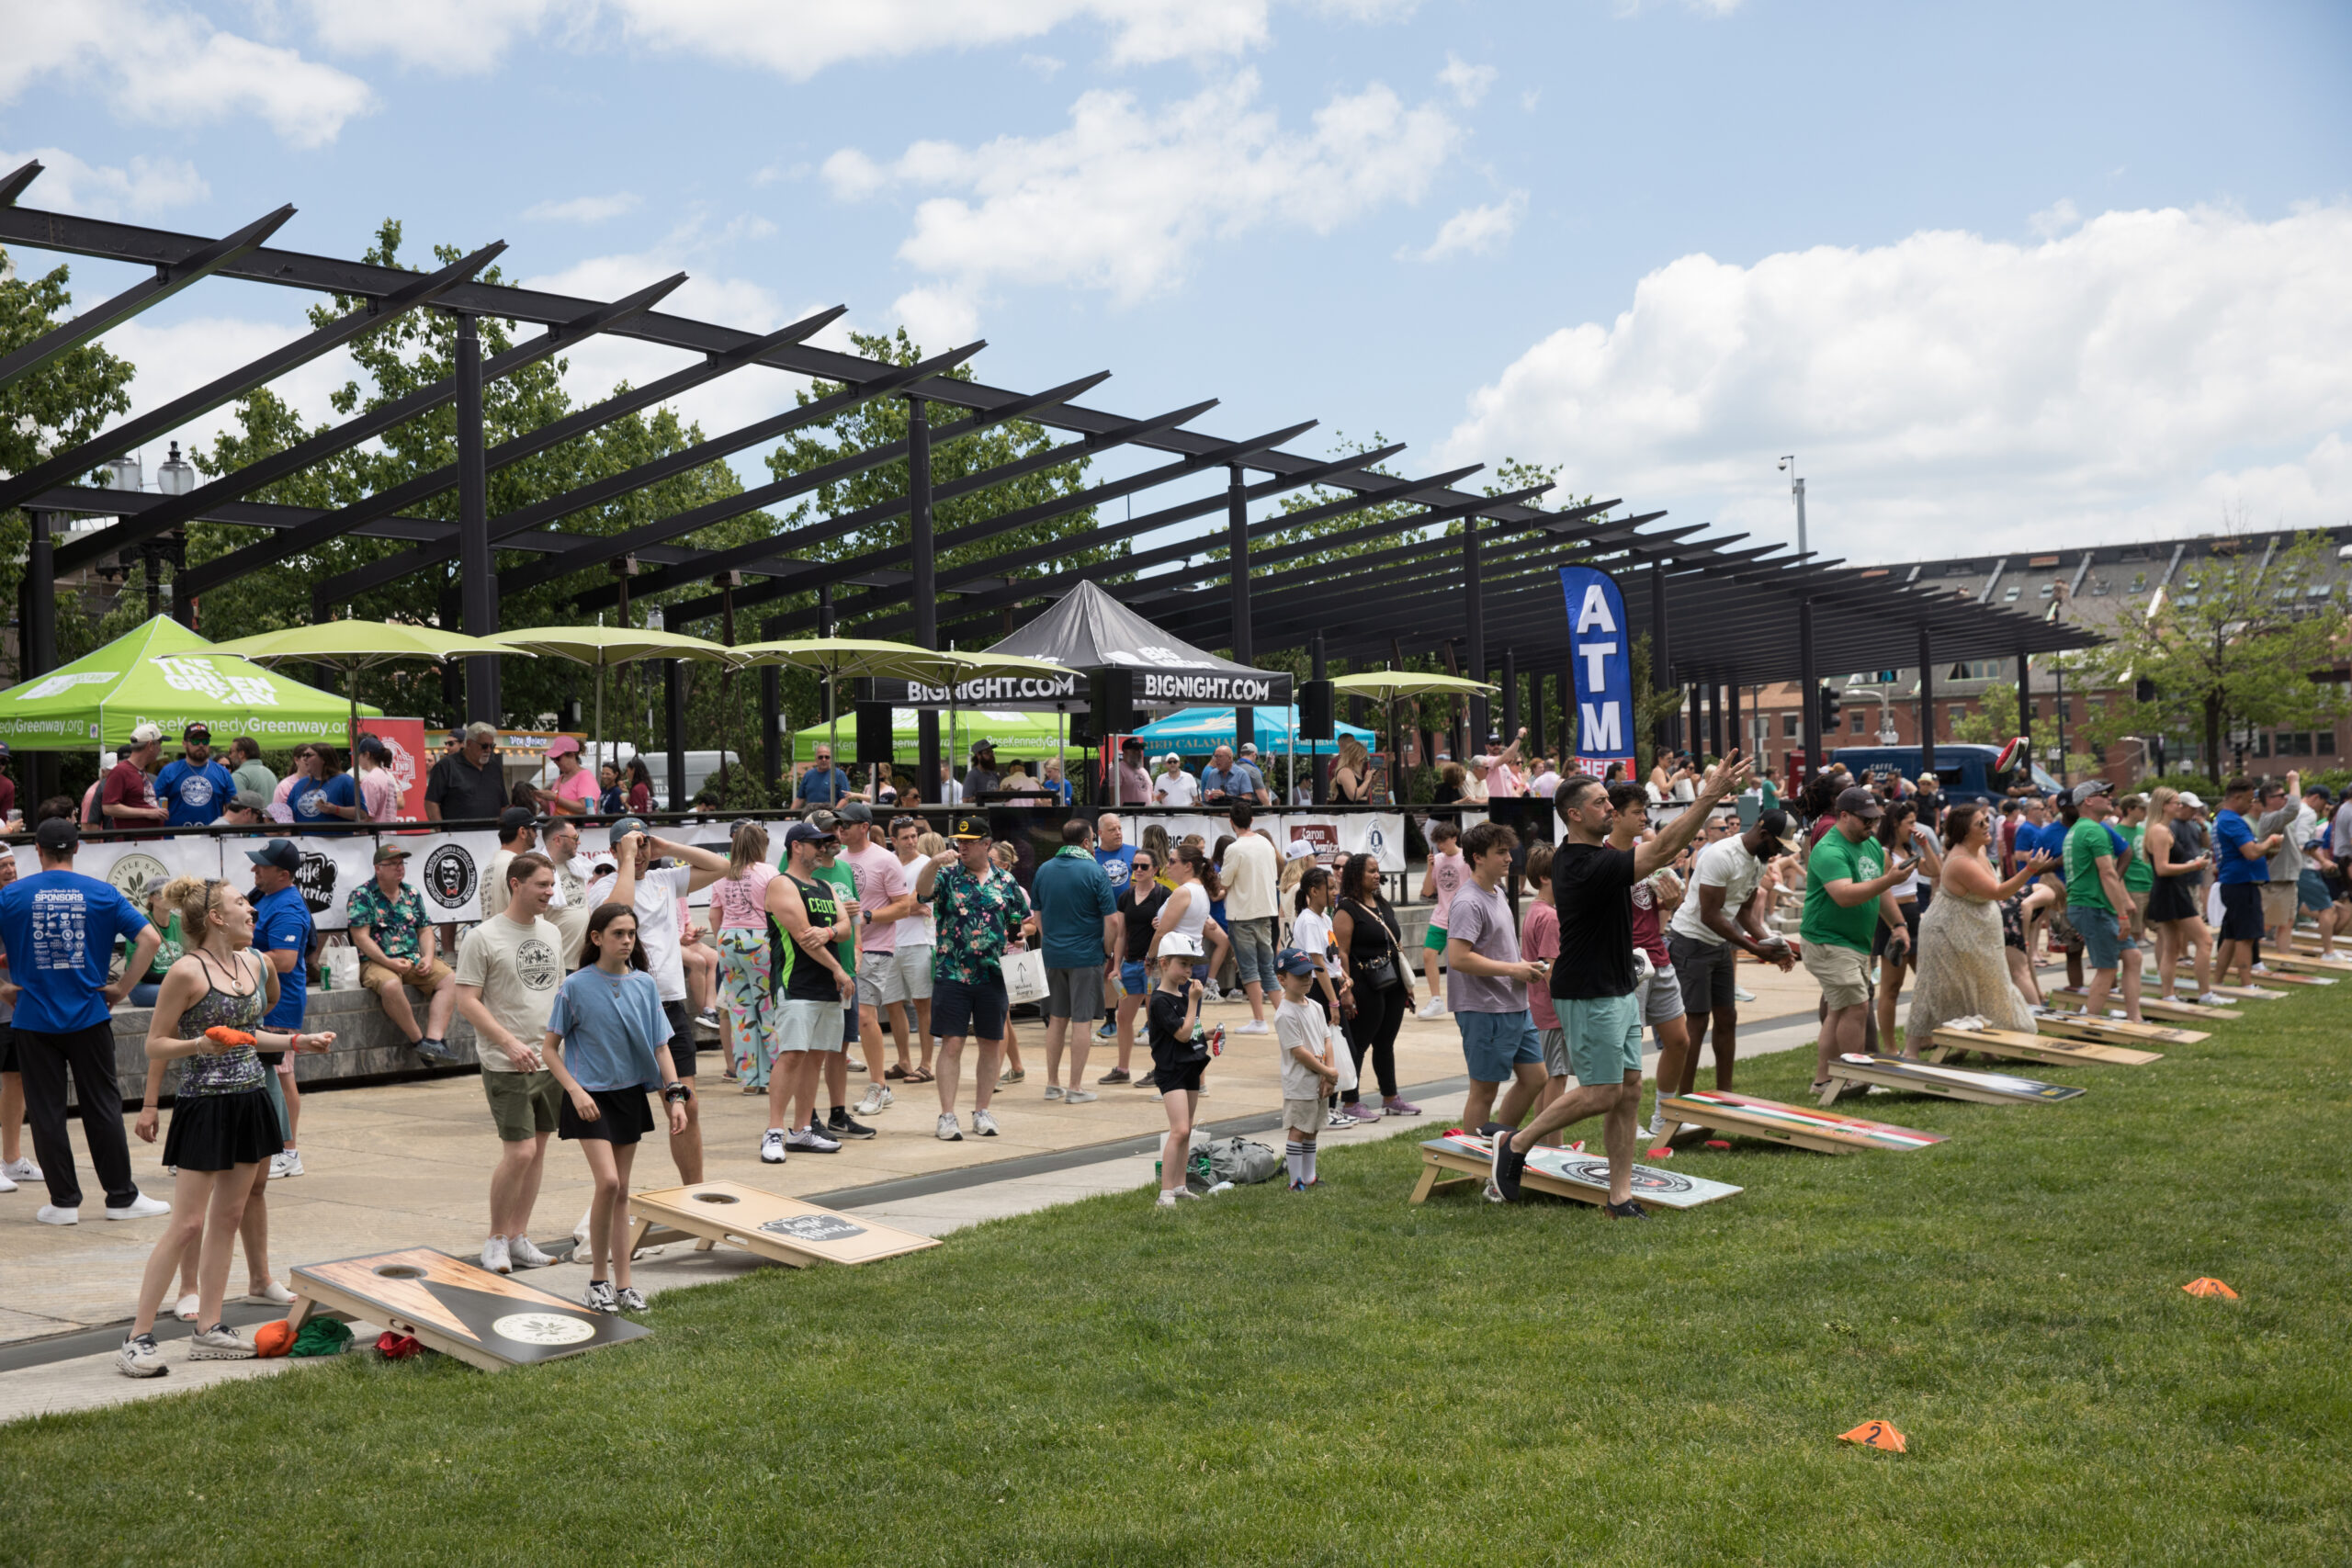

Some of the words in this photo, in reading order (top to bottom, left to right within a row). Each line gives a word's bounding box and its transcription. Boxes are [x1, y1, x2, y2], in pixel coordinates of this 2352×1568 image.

[1577, 585, 1623, 751] ATM
[1145, 673, 1270, 701] BIGNIGHT.COM
[1176, 737, 1237, 749] CALAMA
[1579, 761, 1626, 780] HE
[144, 863, 162, 877] SA
[295, 863, 321, 882] affé
[35, 893, 84, 901] SPONSORS
[300, 885, 333, 902] toria
[808, 897, 837, 915] CELTIC
[1864, 1425, 1882, 1445] 2
